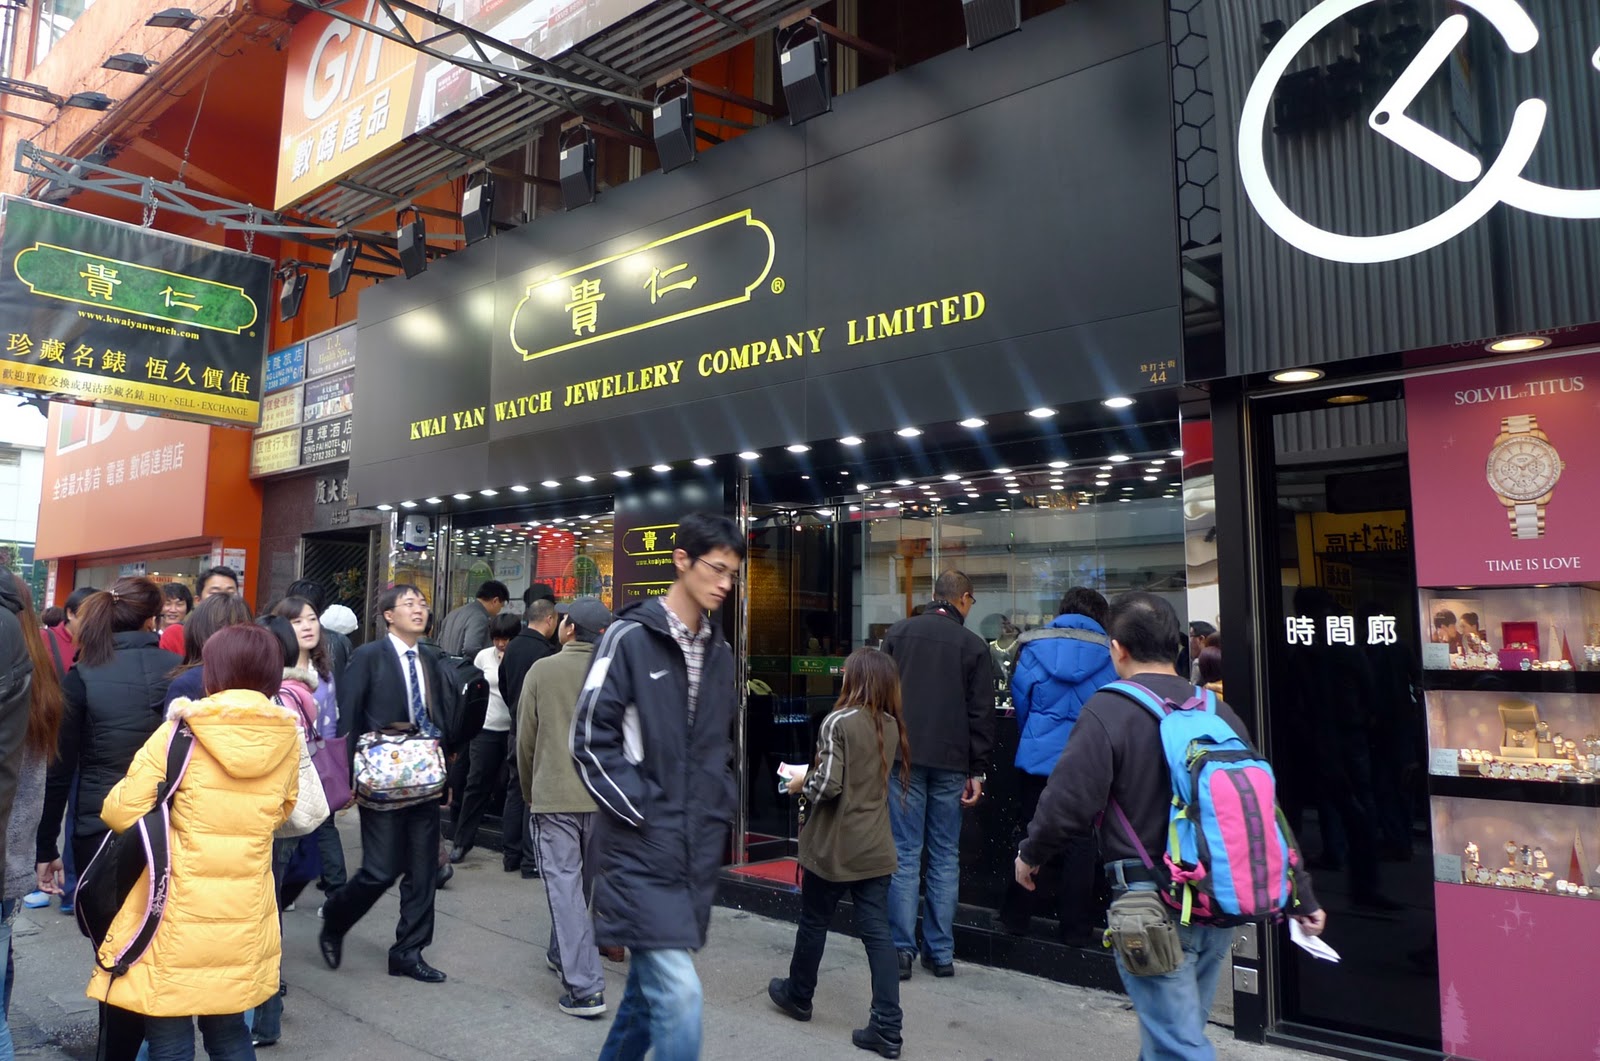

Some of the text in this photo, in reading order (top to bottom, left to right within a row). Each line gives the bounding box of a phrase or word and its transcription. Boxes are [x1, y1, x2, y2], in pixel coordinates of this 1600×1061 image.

[79, 263, 204, 312] 貴仁
[565, 262, 697, 336] 貴仁
[78, 309, 200, 341] www.kwaiyanwatch.com
[6, 333, 127, 374] 珍藏名錶
[410, 291, 986, 440] KWAI YAN WATCH JEWELLERY COMPANY LIMITED
[1150, 371, 1167, 384] 44
[1454, 384, 1519, 406] SOLVIL
[1525, 376, 1584, 397] TITUS
[148, 392, 168, 404] BUY
[174, 396, 195, 408] SELL
[201, 400, 249, 417] EXCHANGE
[325, 438, 341, 449] HOTEL
[1485, 557, 1581, 572] TIME IS LOVE
[1285, 613, 1398, 646] 時間廊
